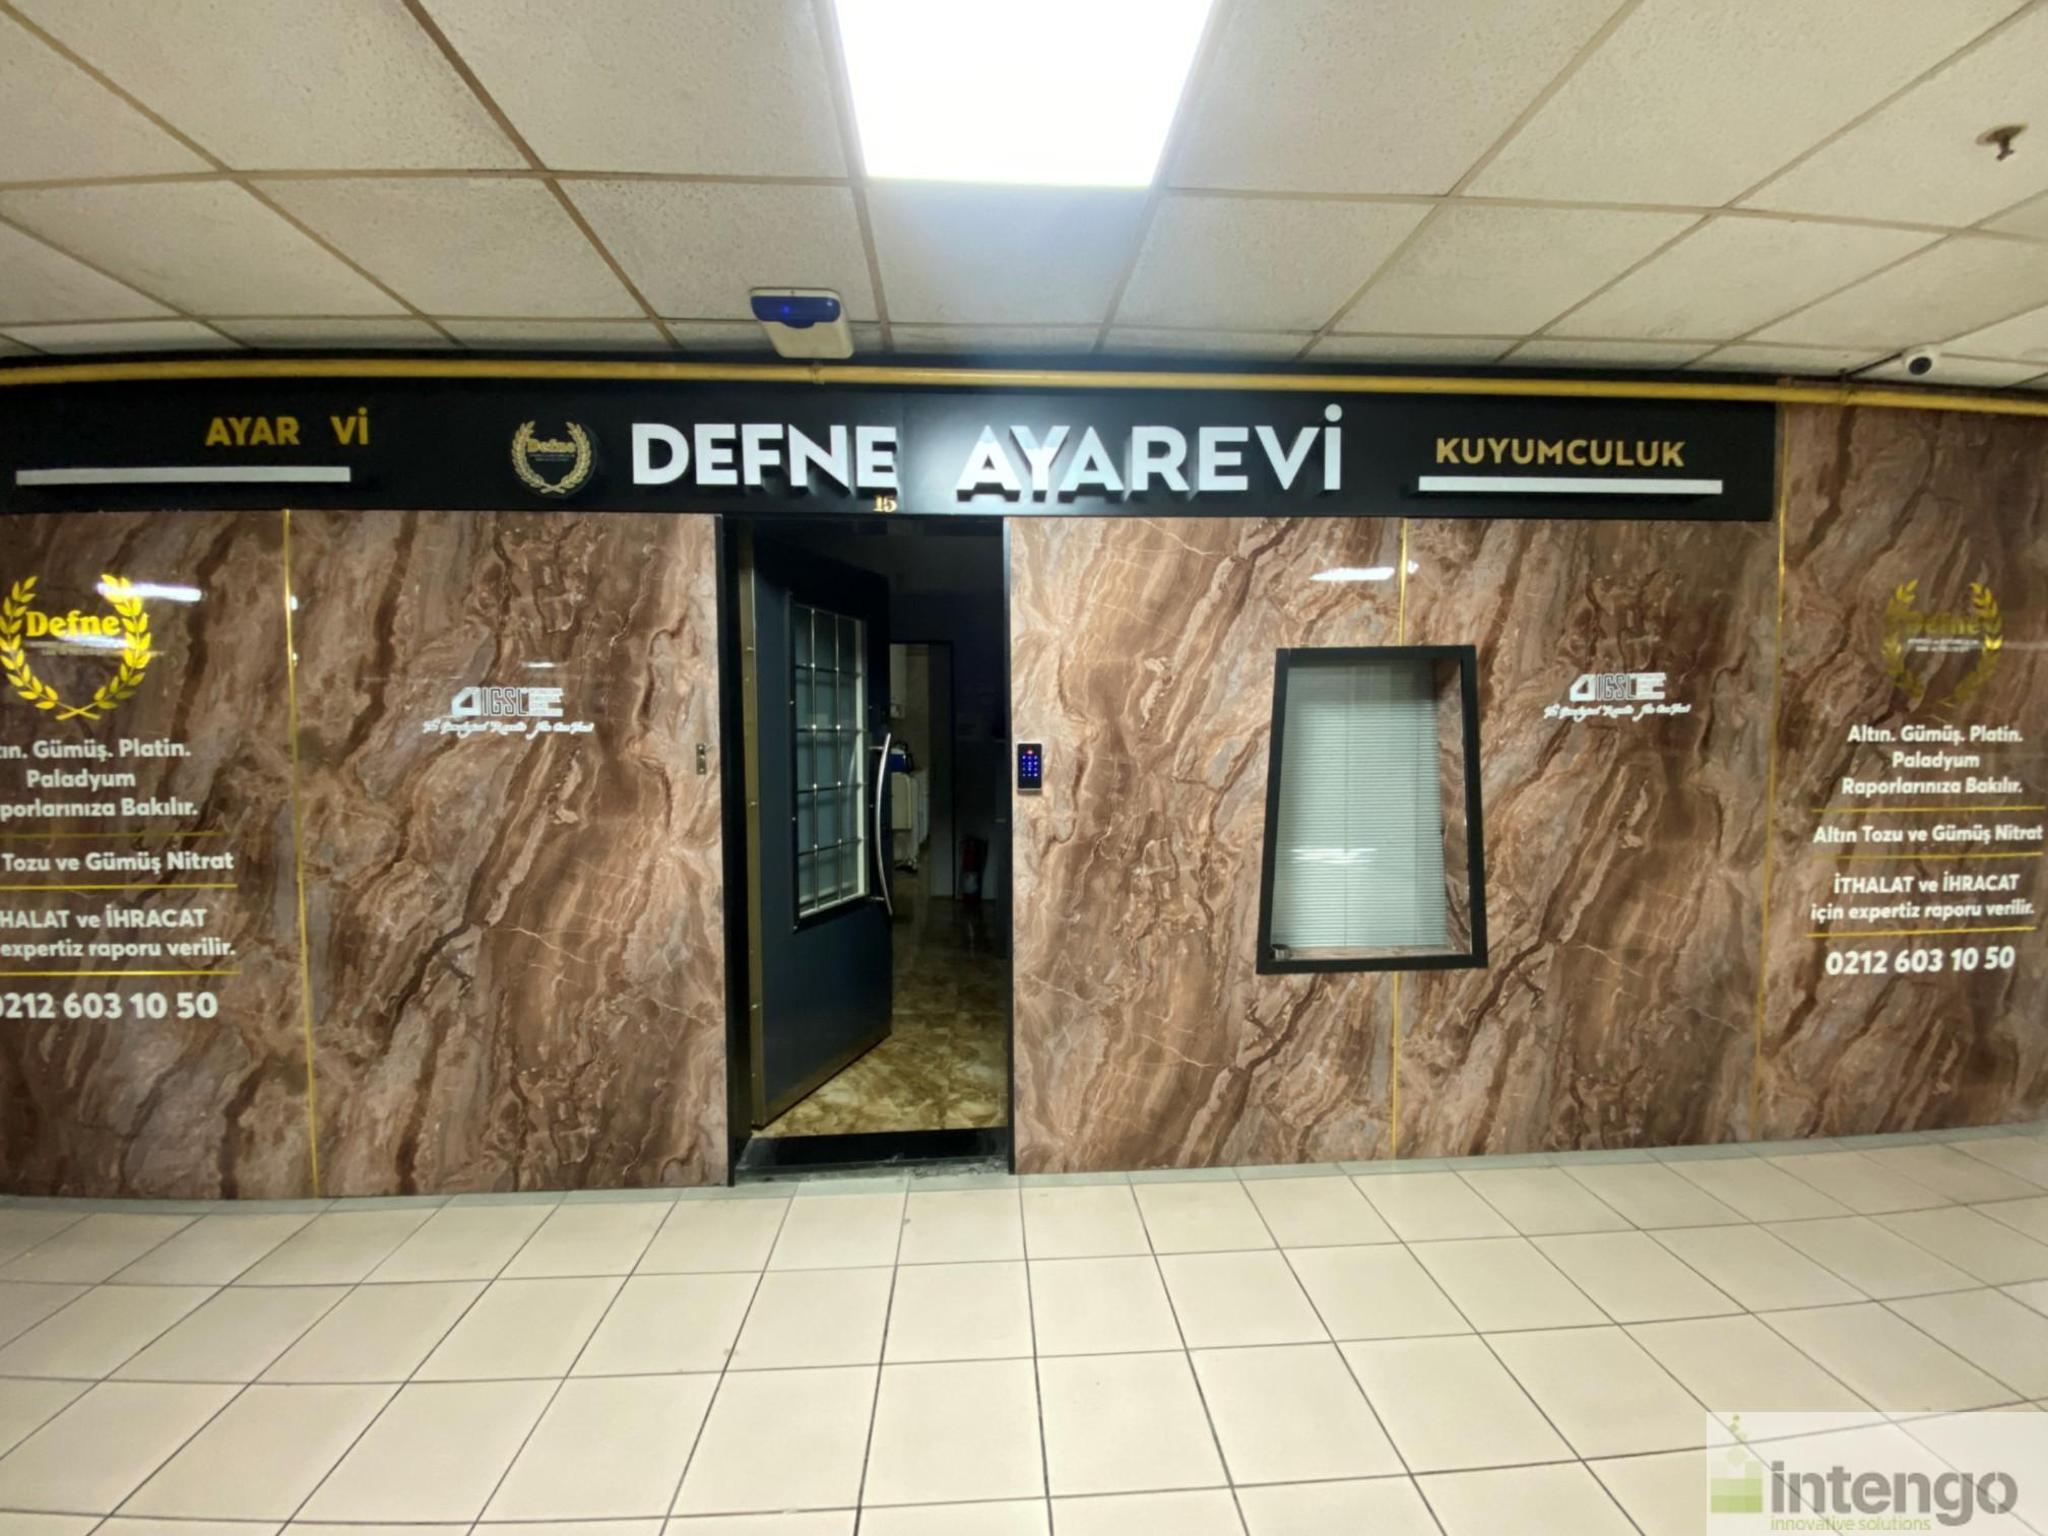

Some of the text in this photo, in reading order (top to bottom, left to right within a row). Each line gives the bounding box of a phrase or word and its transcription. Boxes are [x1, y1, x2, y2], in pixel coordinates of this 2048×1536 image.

[205, 416, 300, 446] AYAR
[631, 403, 1343, 493] DEFNE AYAREVİ
[1436, 437, 1685, 468] KUYUMCULUK
[873, 495, 898, 513] 15
[26, 610, 121, 638] Defne
[1847, 724, 2025, 747] Altın. Gümüş. Platin.
[32, 739, 114, 763] Gümüş.
[118, 738, 192, 758] Platin.
[1891, 751, 1981, 772] Paladyum
[26, 768, 136, 792] Paladyum
[1841, 777, 2024, 799] Raporlarınıza Bakılır.
[121, 796, 199, 817] Bakılır.
[1812, 824, 2044, 845] Altın Tozu ve Gümüş Nitrat
[2, 850, 235, 874] Tozu ve Gümüş Nitrat
[1833, 871, 2021, 894] İTHALAT ve İHRACAT
[76, 914, 100, 929] ve
[105, 904, 208, 928] İHRACAT
[1810, 898, 2036, 924] için expertiz raporu verilir.
[2, 937, 237, 961] expertiz raporu verilir.
[1825, 945, 2017, 976] 0212 603 10 50
[0, 992, 219, 1019] 212 603 10 50
